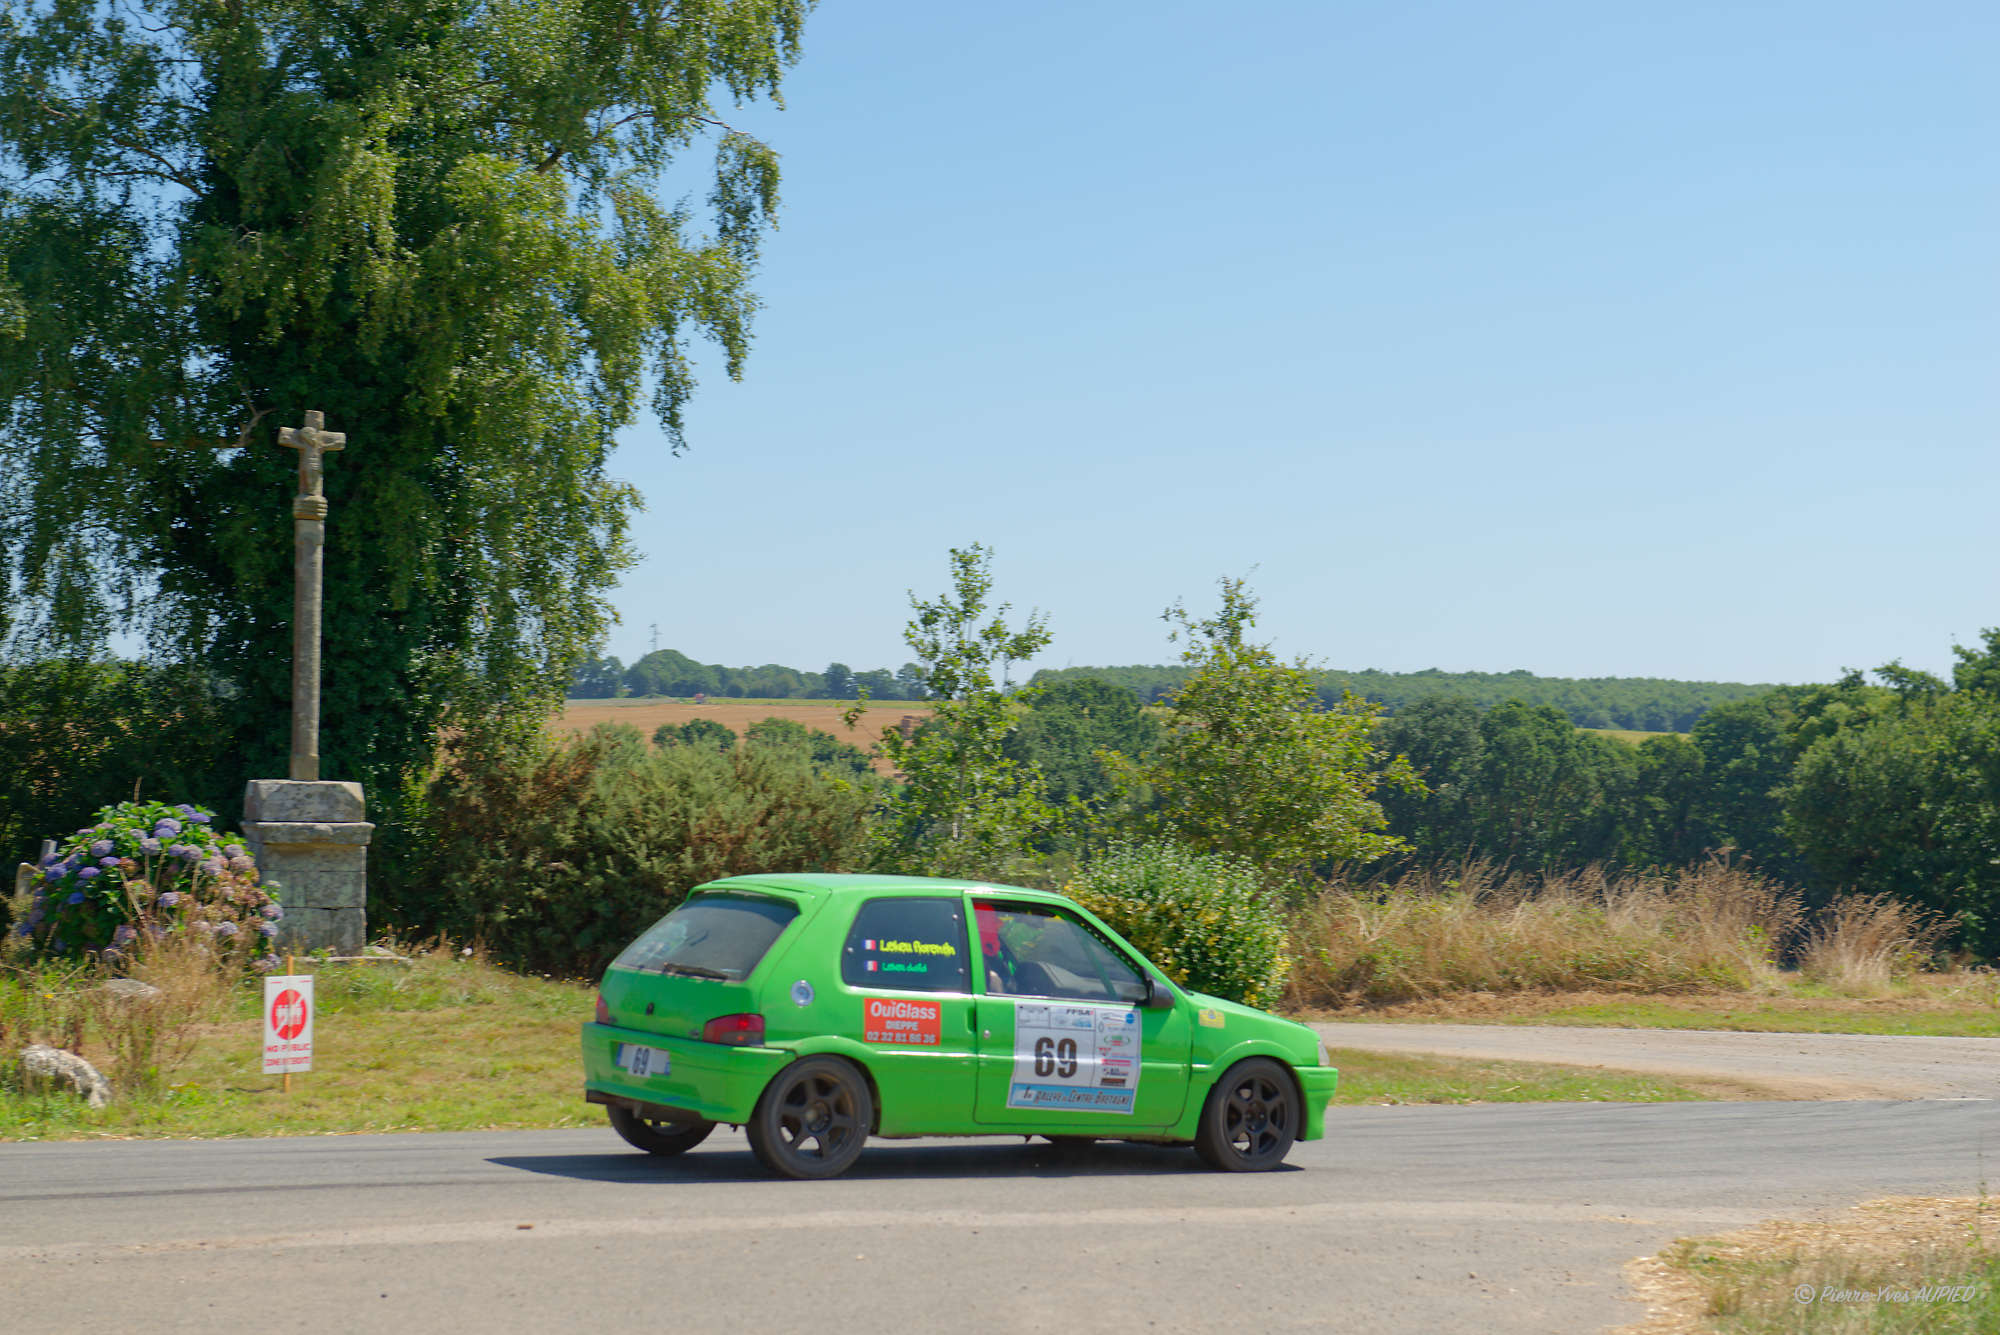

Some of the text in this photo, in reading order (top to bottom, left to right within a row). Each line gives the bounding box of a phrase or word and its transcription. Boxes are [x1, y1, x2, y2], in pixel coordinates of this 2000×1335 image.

[870, 1000, 936, 1019] OuiGlass
[886, 1020, 919, 1031] DIEPPE
[632, 1047, 650, 1075] 69
[1035, 1037, 1078, 1078] 69
